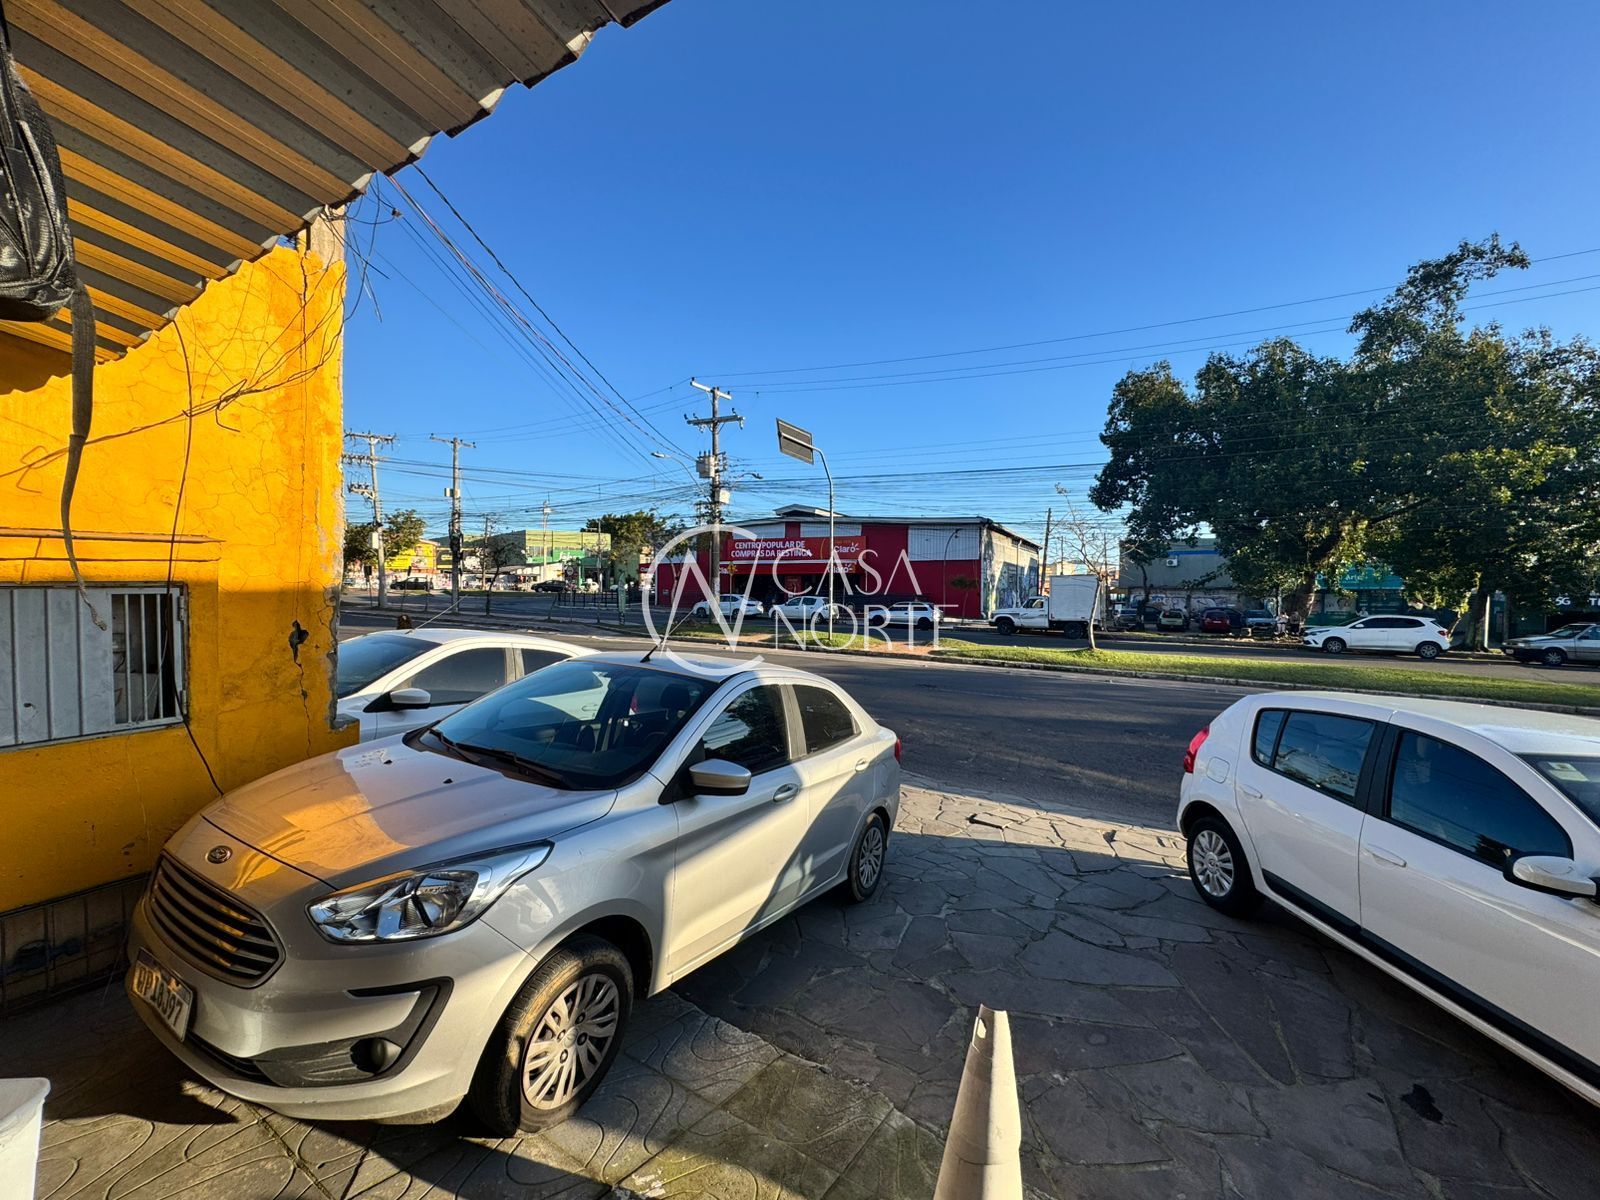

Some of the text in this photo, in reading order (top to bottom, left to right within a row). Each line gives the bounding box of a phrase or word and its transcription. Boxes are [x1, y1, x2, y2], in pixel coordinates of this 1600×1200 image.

[735, 540, 806, 549] CENTRO POPULAR DE
[833, 543, 857, 553] Claro
[731, 549, 765, 558] COMPRAS
[765, 549, 776, 558] DA
[1555, 596, 1571, 606] 5G
